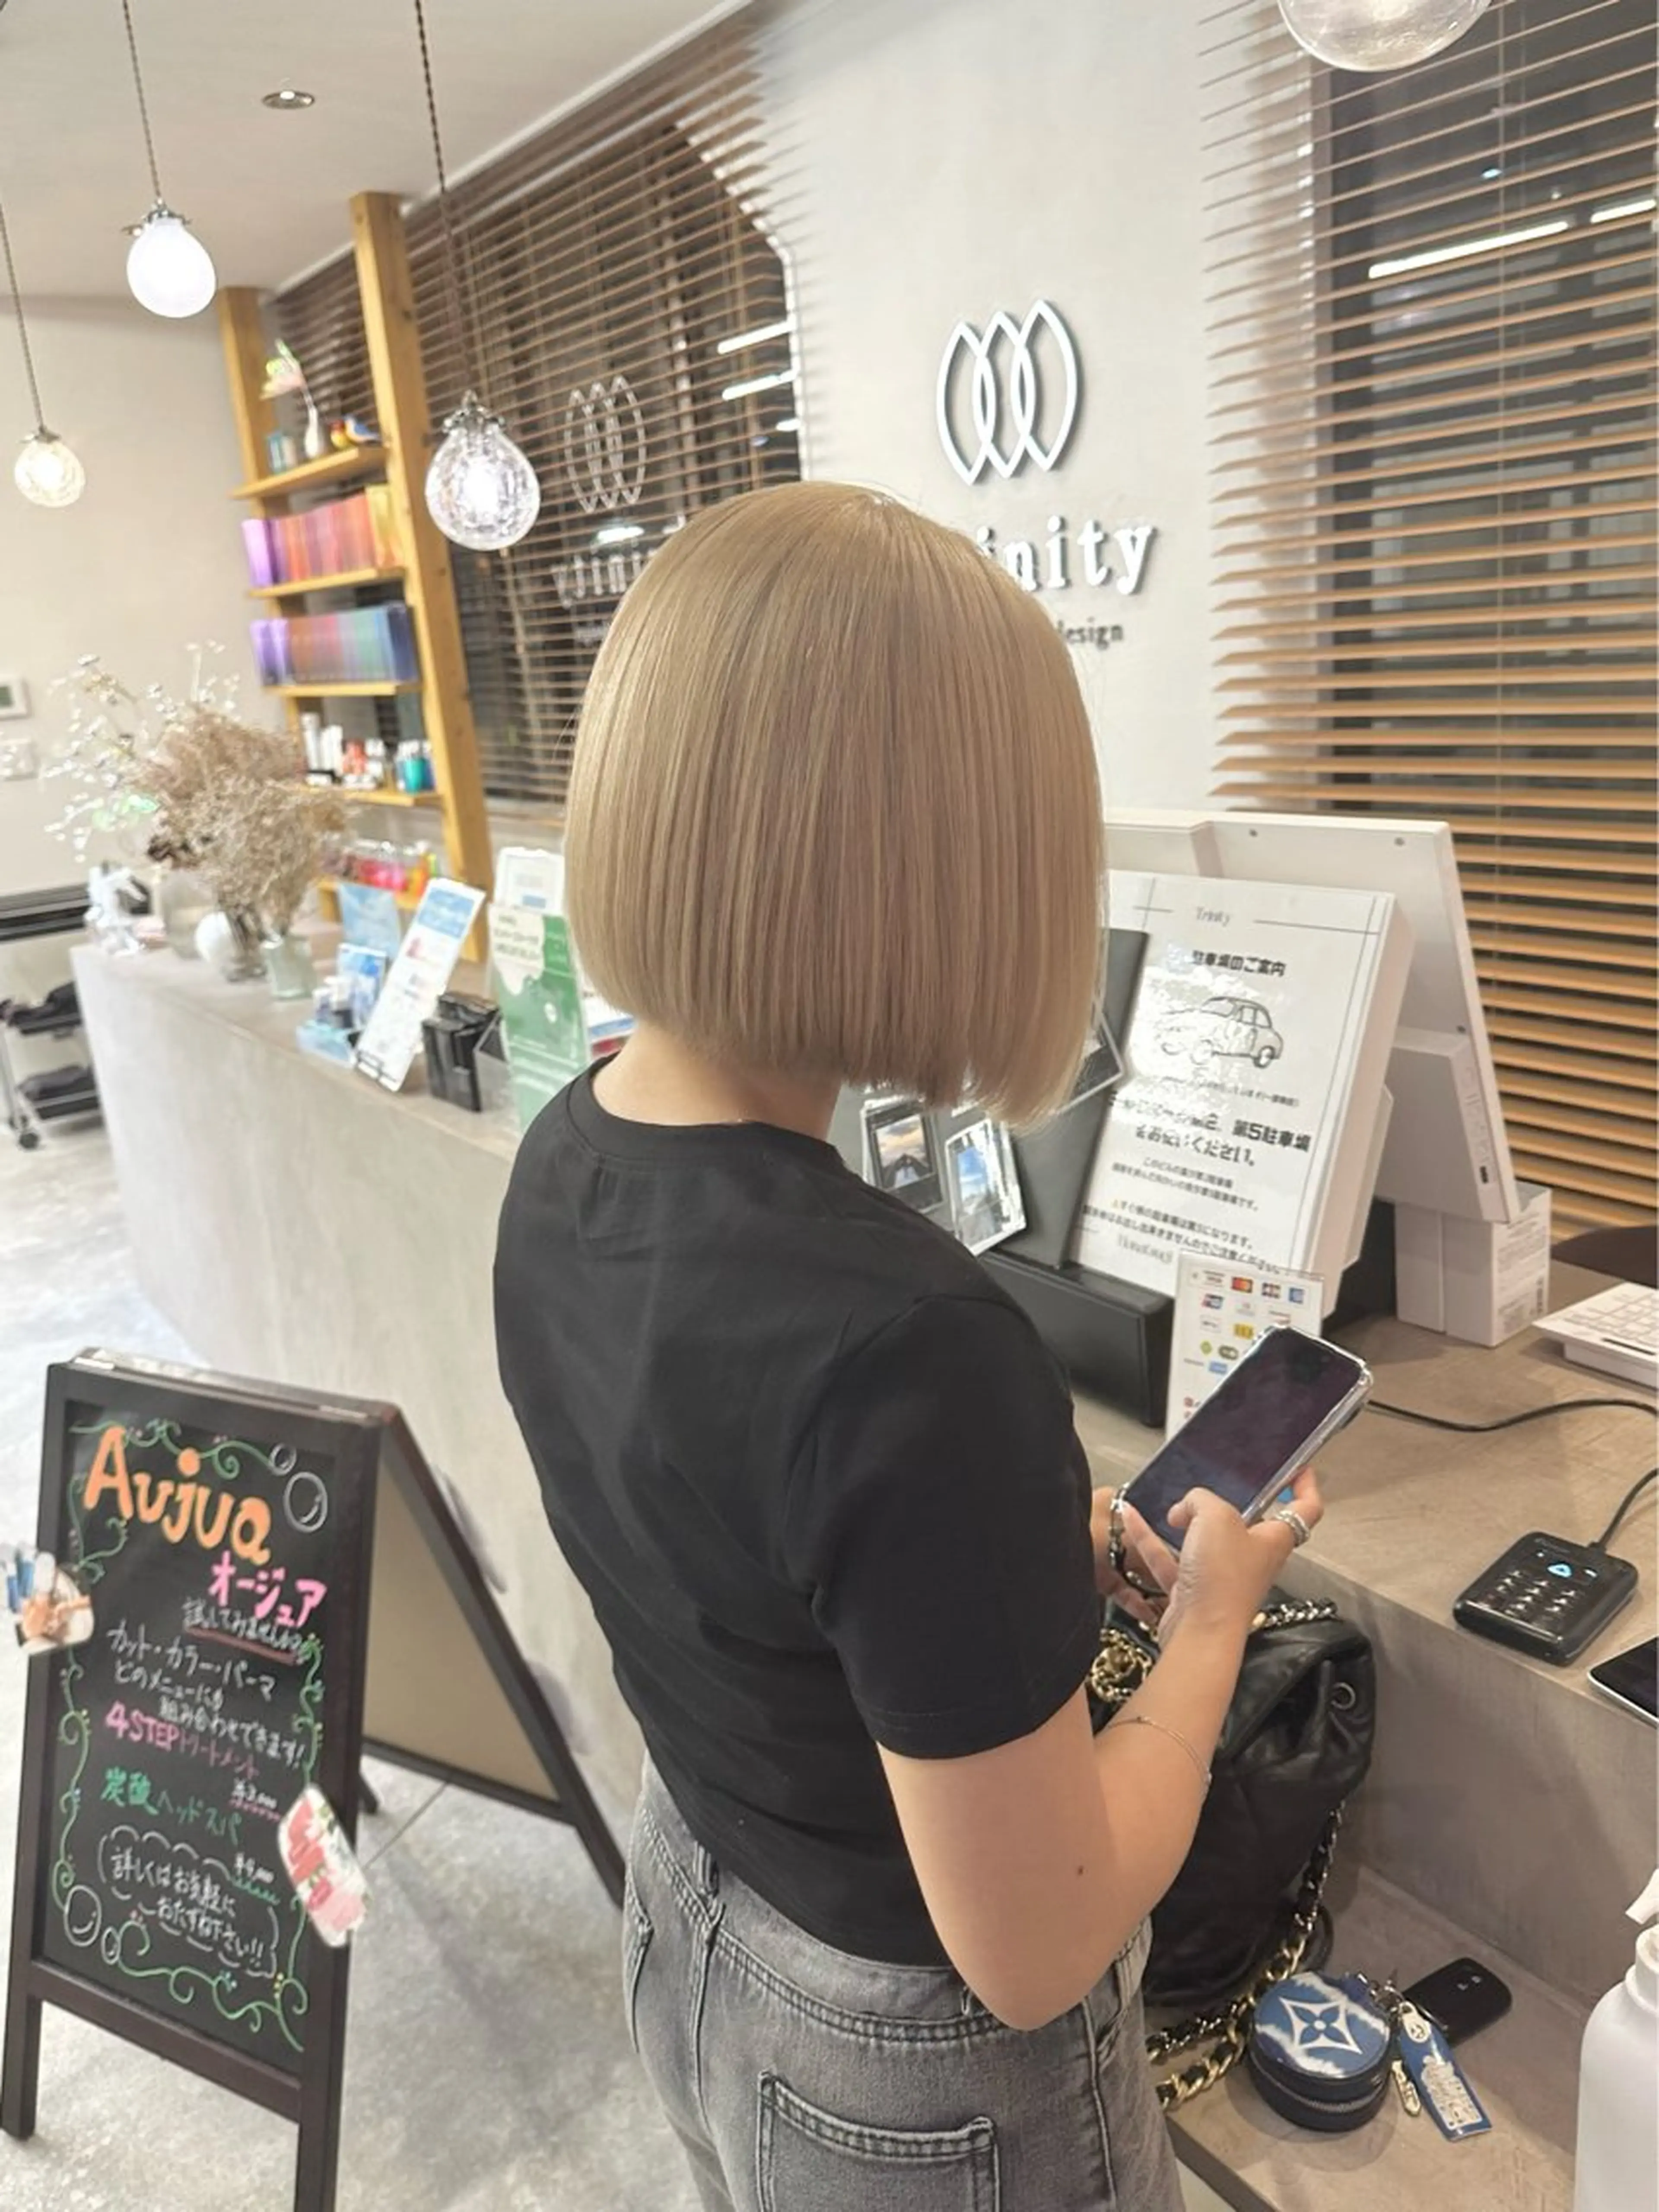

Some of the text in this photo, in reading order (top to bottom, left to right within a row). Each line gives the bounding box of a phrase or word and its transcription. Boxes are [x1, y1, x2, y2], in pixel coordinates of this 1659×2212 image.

[977, 515, 1153, 595] nity
[209, 1551, 327, 1627] オージュア
